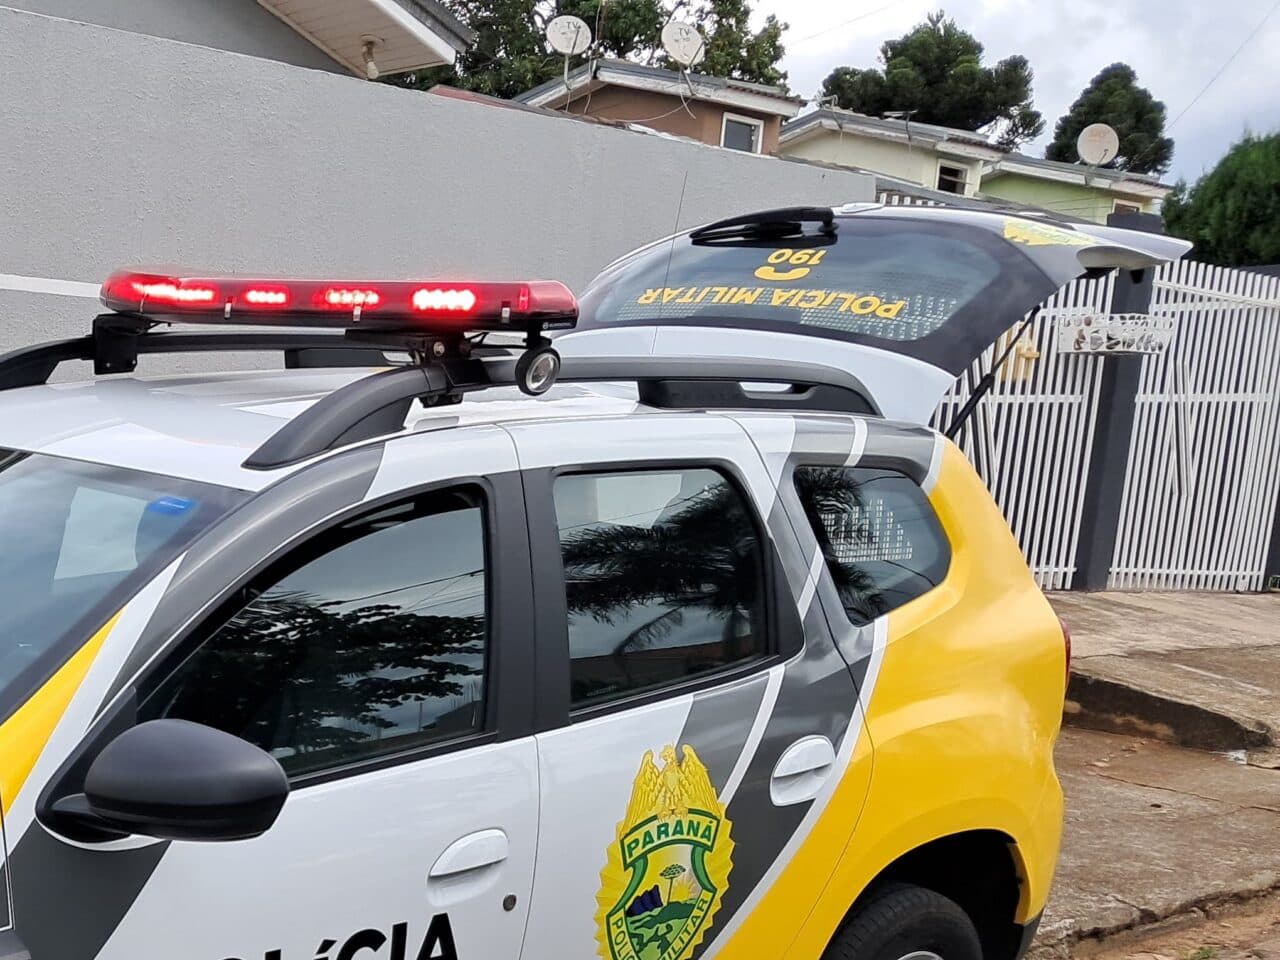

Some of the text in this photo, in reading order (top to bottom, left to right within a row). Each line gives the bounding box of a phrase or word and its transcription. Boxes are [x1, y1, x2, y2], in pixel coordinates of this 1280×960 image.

[767, 248, 827, 265] 190
[638, 286, 763, 304] MILITAR
[626, 820, 714, 858] PARANÁ
